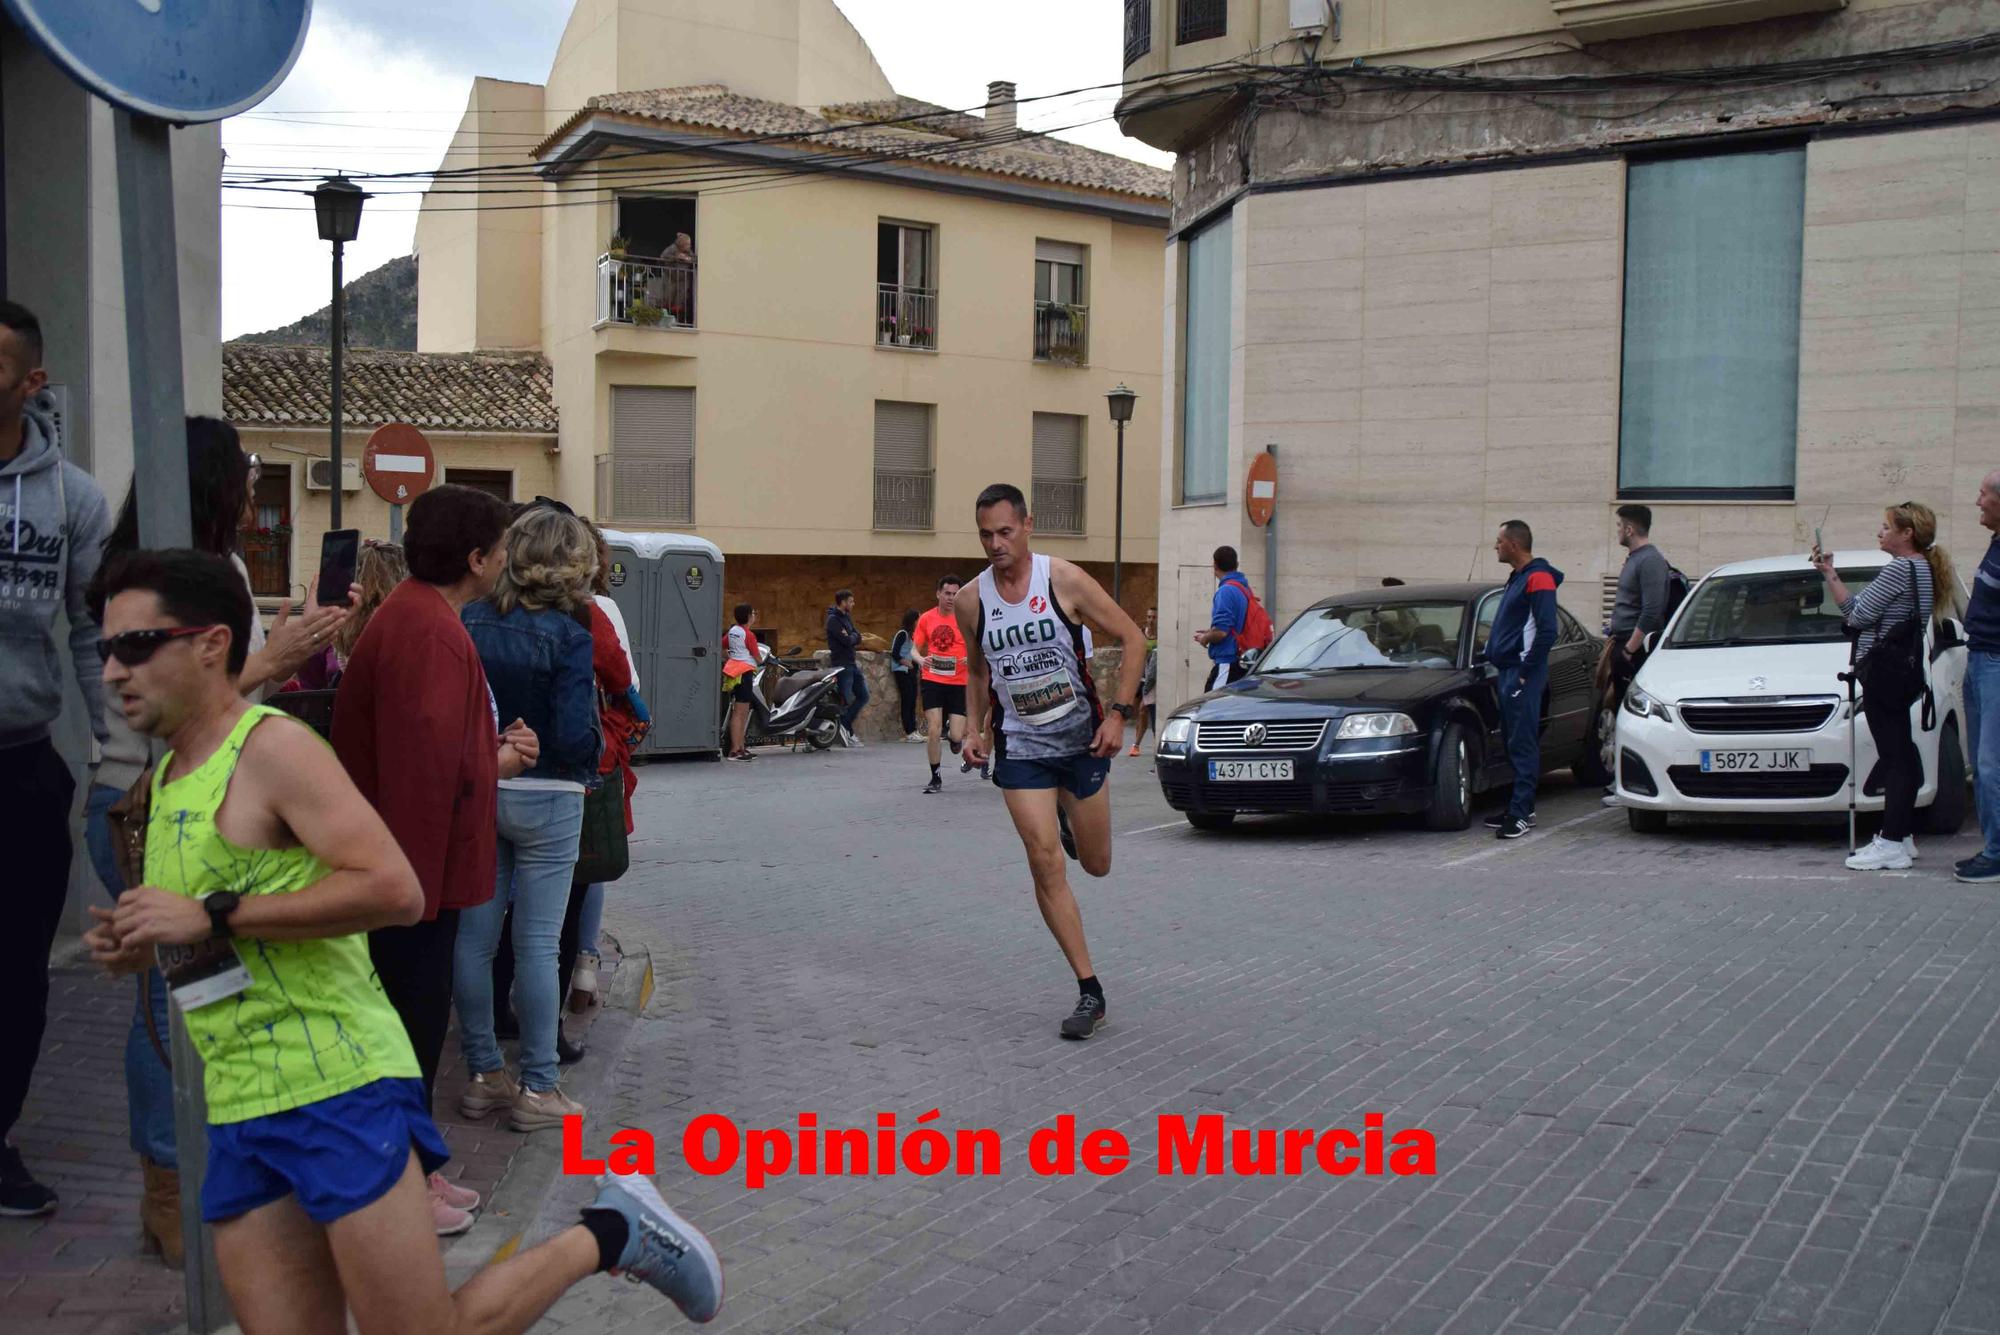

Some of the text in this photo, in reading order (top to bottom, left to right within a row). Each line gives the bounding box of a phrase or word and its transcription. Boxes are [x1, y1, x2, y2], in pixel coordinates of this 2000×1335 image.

[988, 618, 1056, 652] UNED
[1715, 752, 1799, 769] 5872 JJK
[1218, 762, 1289, 778] 4371 CYS
